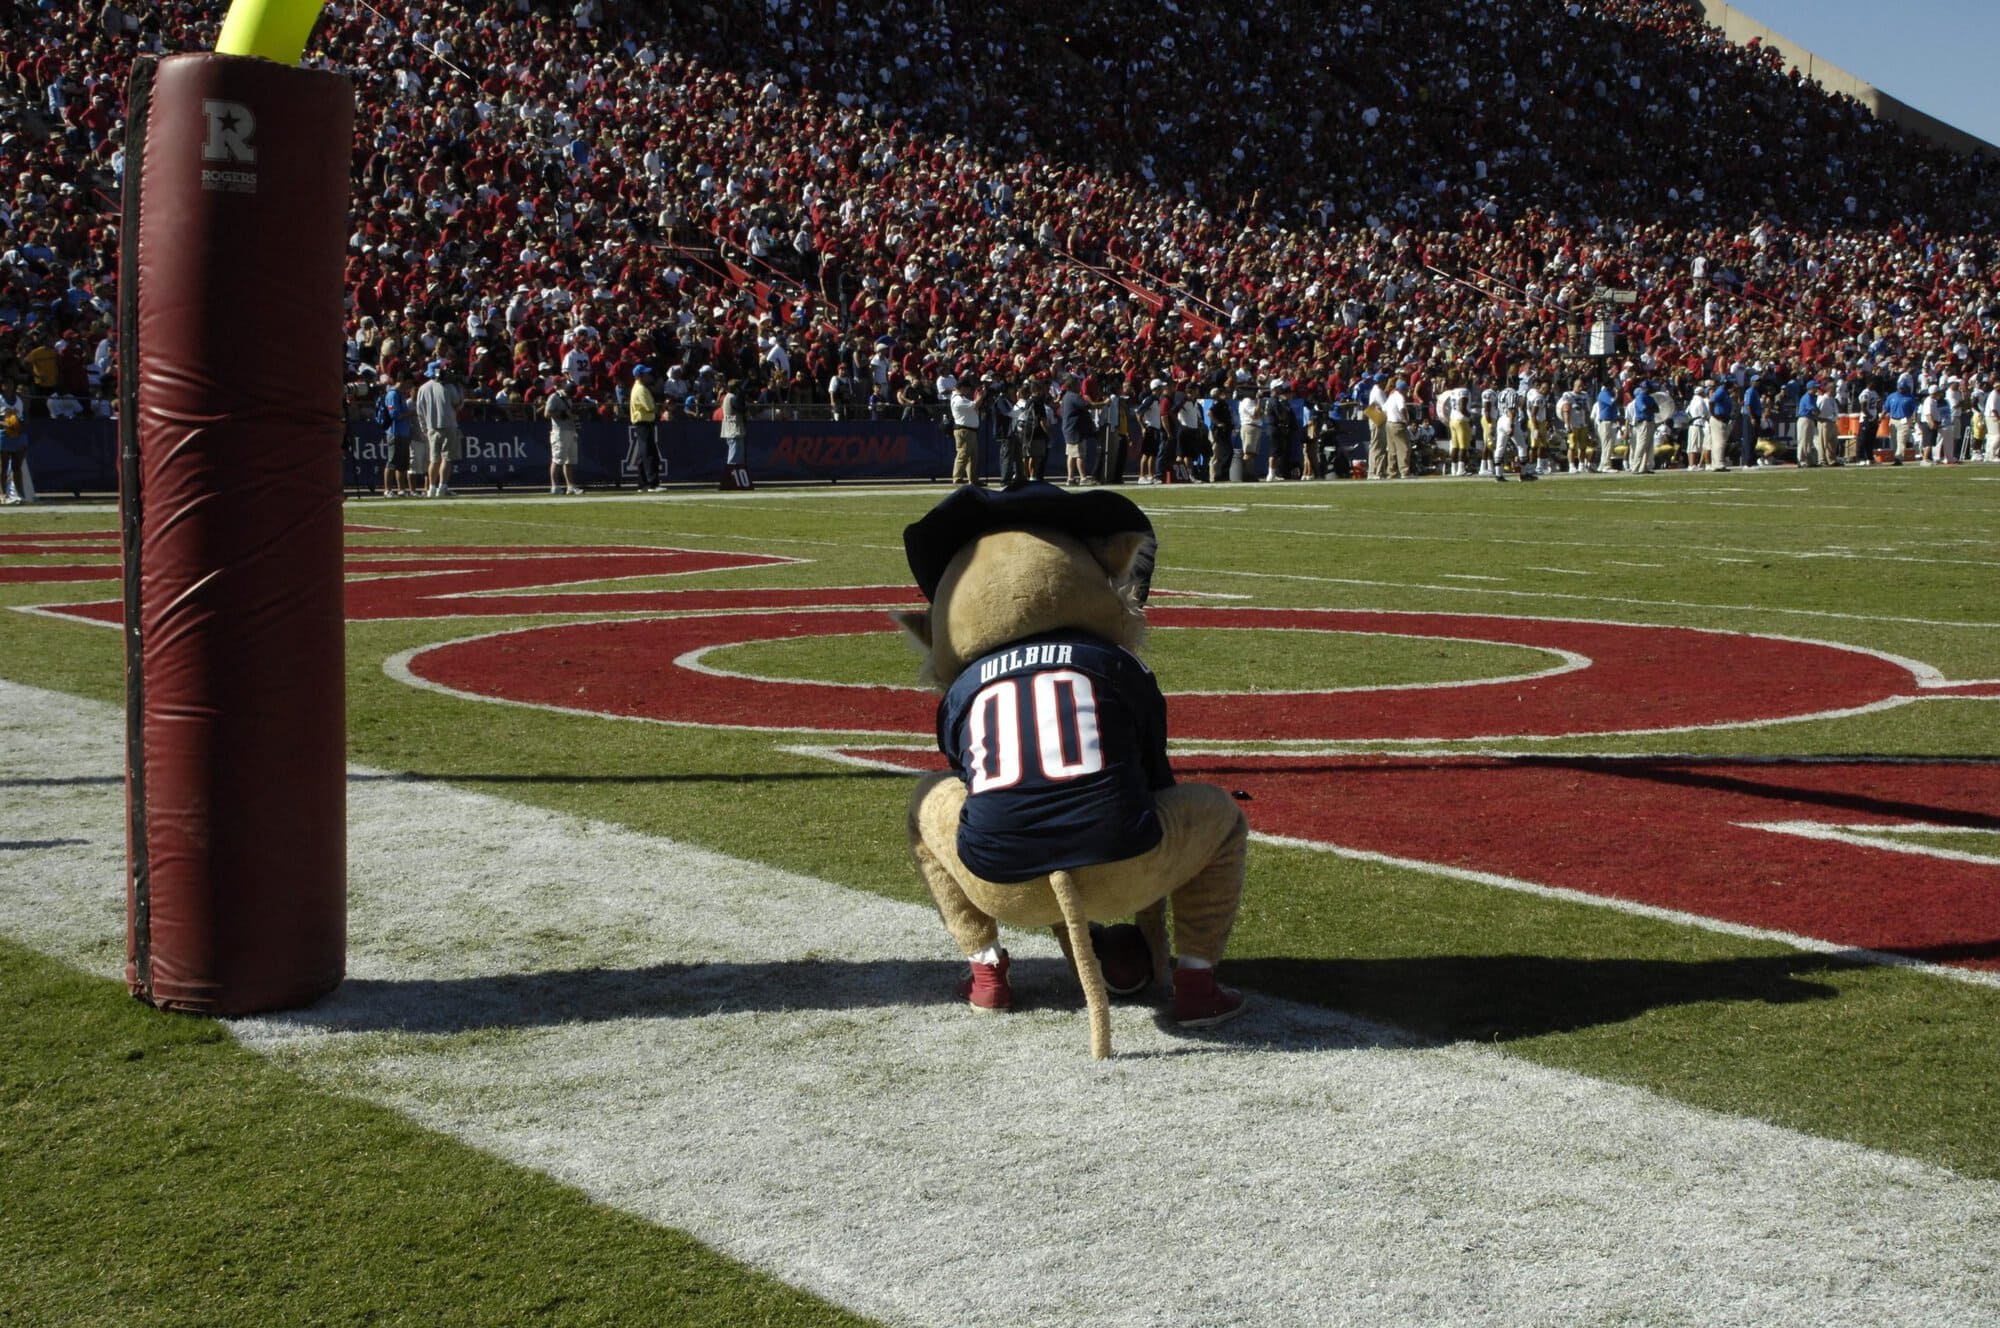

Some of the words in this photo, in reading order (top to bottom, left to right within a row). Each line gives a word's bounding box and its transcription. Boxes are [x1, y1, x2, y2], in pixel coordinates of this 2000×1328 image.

[201, 169, 257, 184] ROGERS
[466, 435, 528, 459] Bank
[769, 434, 910, 467] ARIZONA
[731, 468, 750, 488] 10
[980, 644, 1073, 684] WILBUR
[968, 668, 1105, 795] 00
